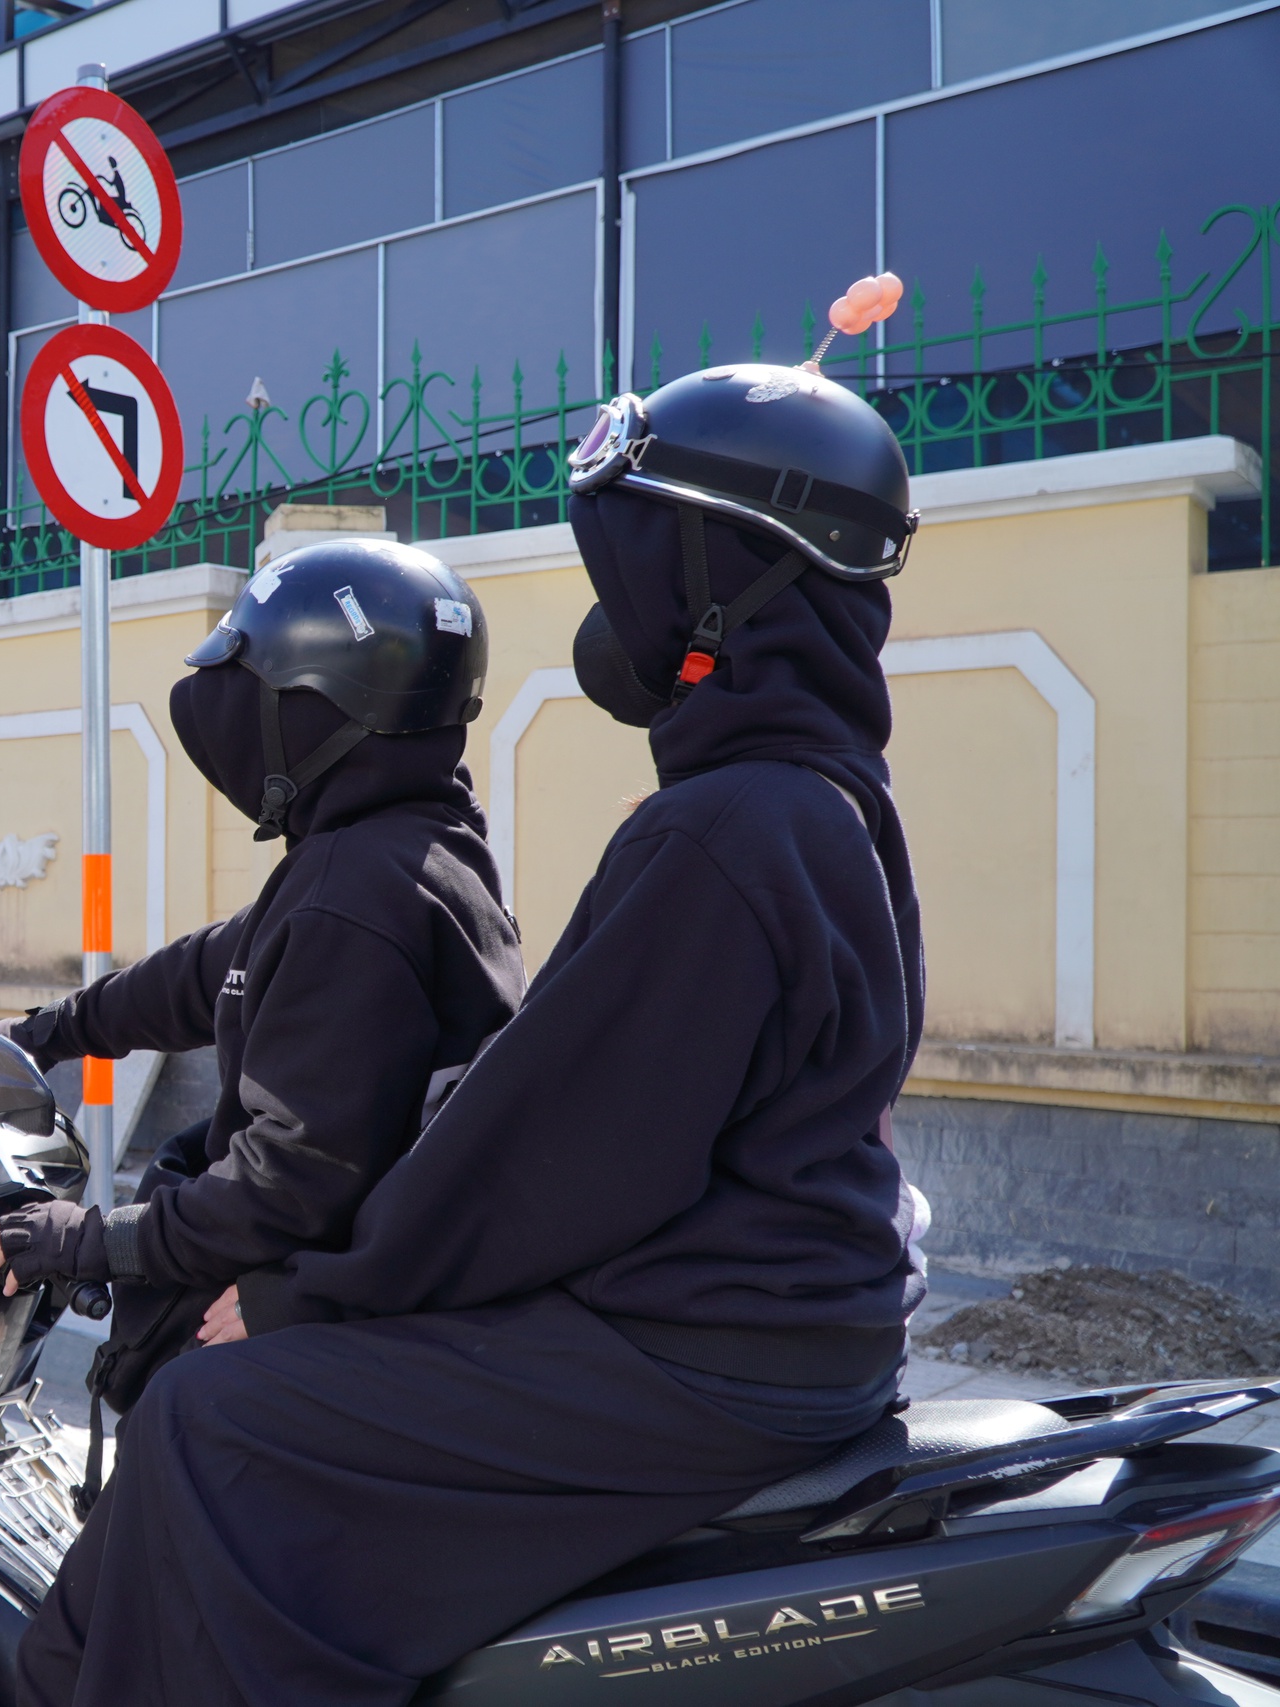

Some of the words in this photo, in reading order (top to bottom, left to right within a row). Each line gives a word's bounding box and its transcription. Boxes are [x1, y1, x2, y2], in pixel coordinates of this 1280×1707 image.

[538, 1582, 926, 1671] AIRBLADE
[651, 1652, 721, 1674] BLACK
[734, 1635, 822, 1660] EDITION
